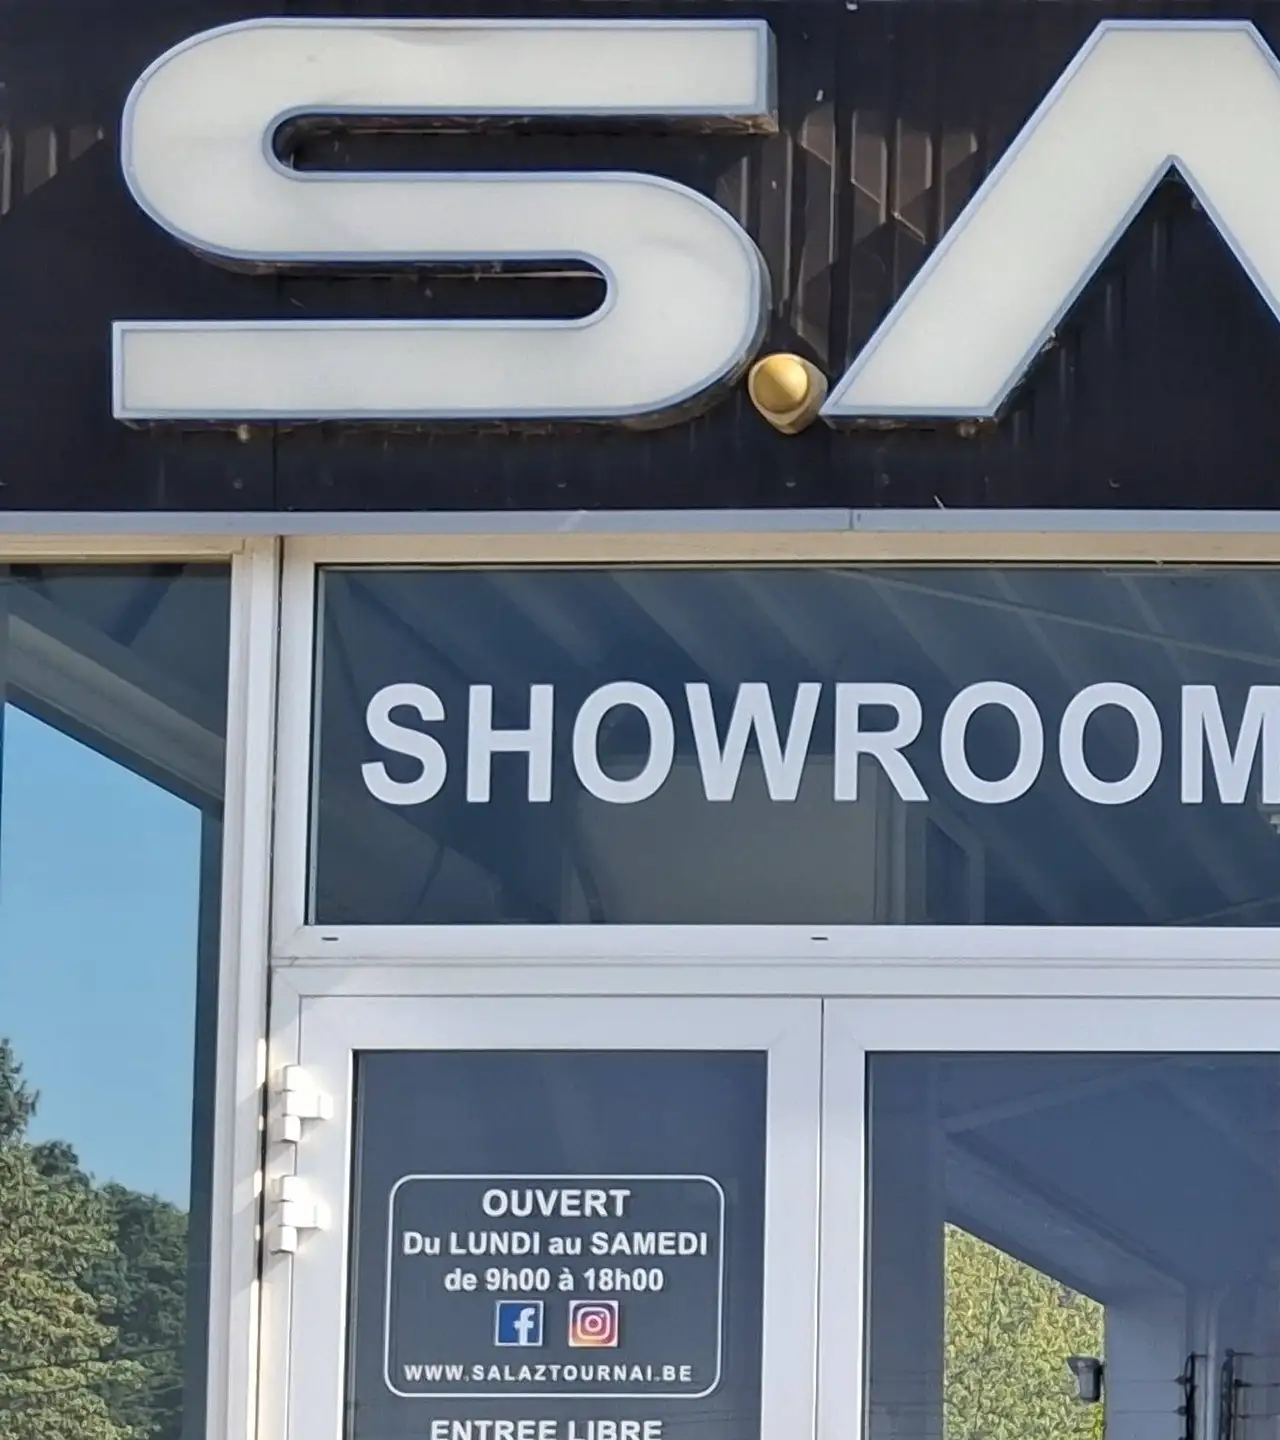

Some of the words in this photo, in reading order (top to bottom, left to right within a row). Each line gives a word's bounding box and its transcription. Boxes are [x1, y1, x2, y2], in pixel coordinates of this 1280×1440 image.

[482, 1188, 631, 1218] OUVERT
[403, 1231, 440, 1256] Du
[449, 1231, 540, 1256] LUNDI
[548, 1236, 582, 1256] au
[590, 1230, 708, 1256] SAMEDI
[444, 1268, 477, 1292] de
[485, 1268, 550, 1292] 9h00
[558, 1268, 575, 1292] à
[583, 1267, 664, 1292] 18h00
[404, 1364, 693, 1382] WWW.SALAZTOURNAI.BE
